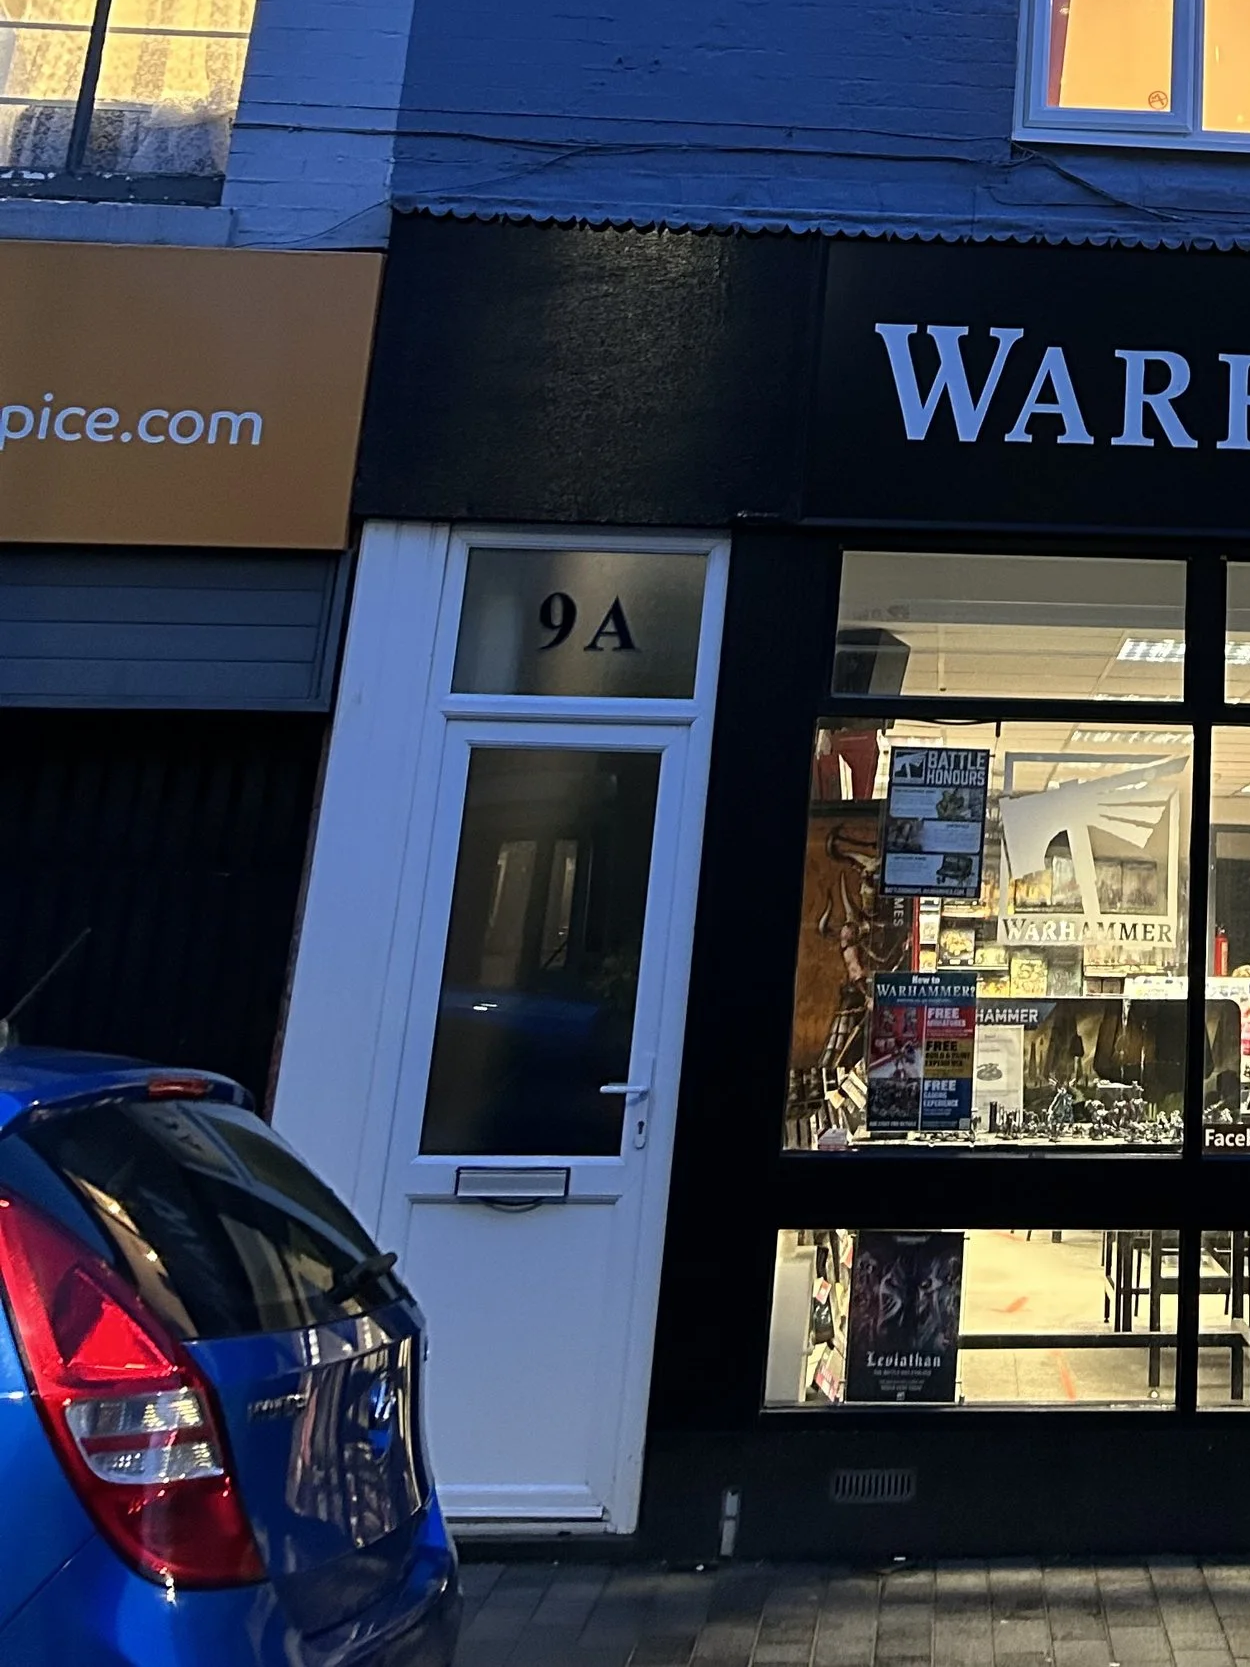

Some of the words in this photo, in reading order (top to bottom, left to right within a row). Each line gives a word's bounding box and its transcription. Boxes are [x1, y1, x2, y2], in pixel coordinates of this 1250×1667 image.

[0, 392, 263, 451] pice.com
[928, 750, 986, 770] BATTLE
[926, 769, 985, 786] HONOURS
[1003, 918, 1172, 943] WARHAMMER
[912, 975, 929, 984] How
[931, 975, 940, 984] to
[877, 984, 976, 997] WARHAMMER?
[927, 1007, 960, 1019] FREE
[976, 1008, 1038, 1023] HAMMER
[926, 1040, 958, 1051] FREE
[924, 1080, 957, 1091] FREE
[867, 1350, 941, 1367] Leviathan
